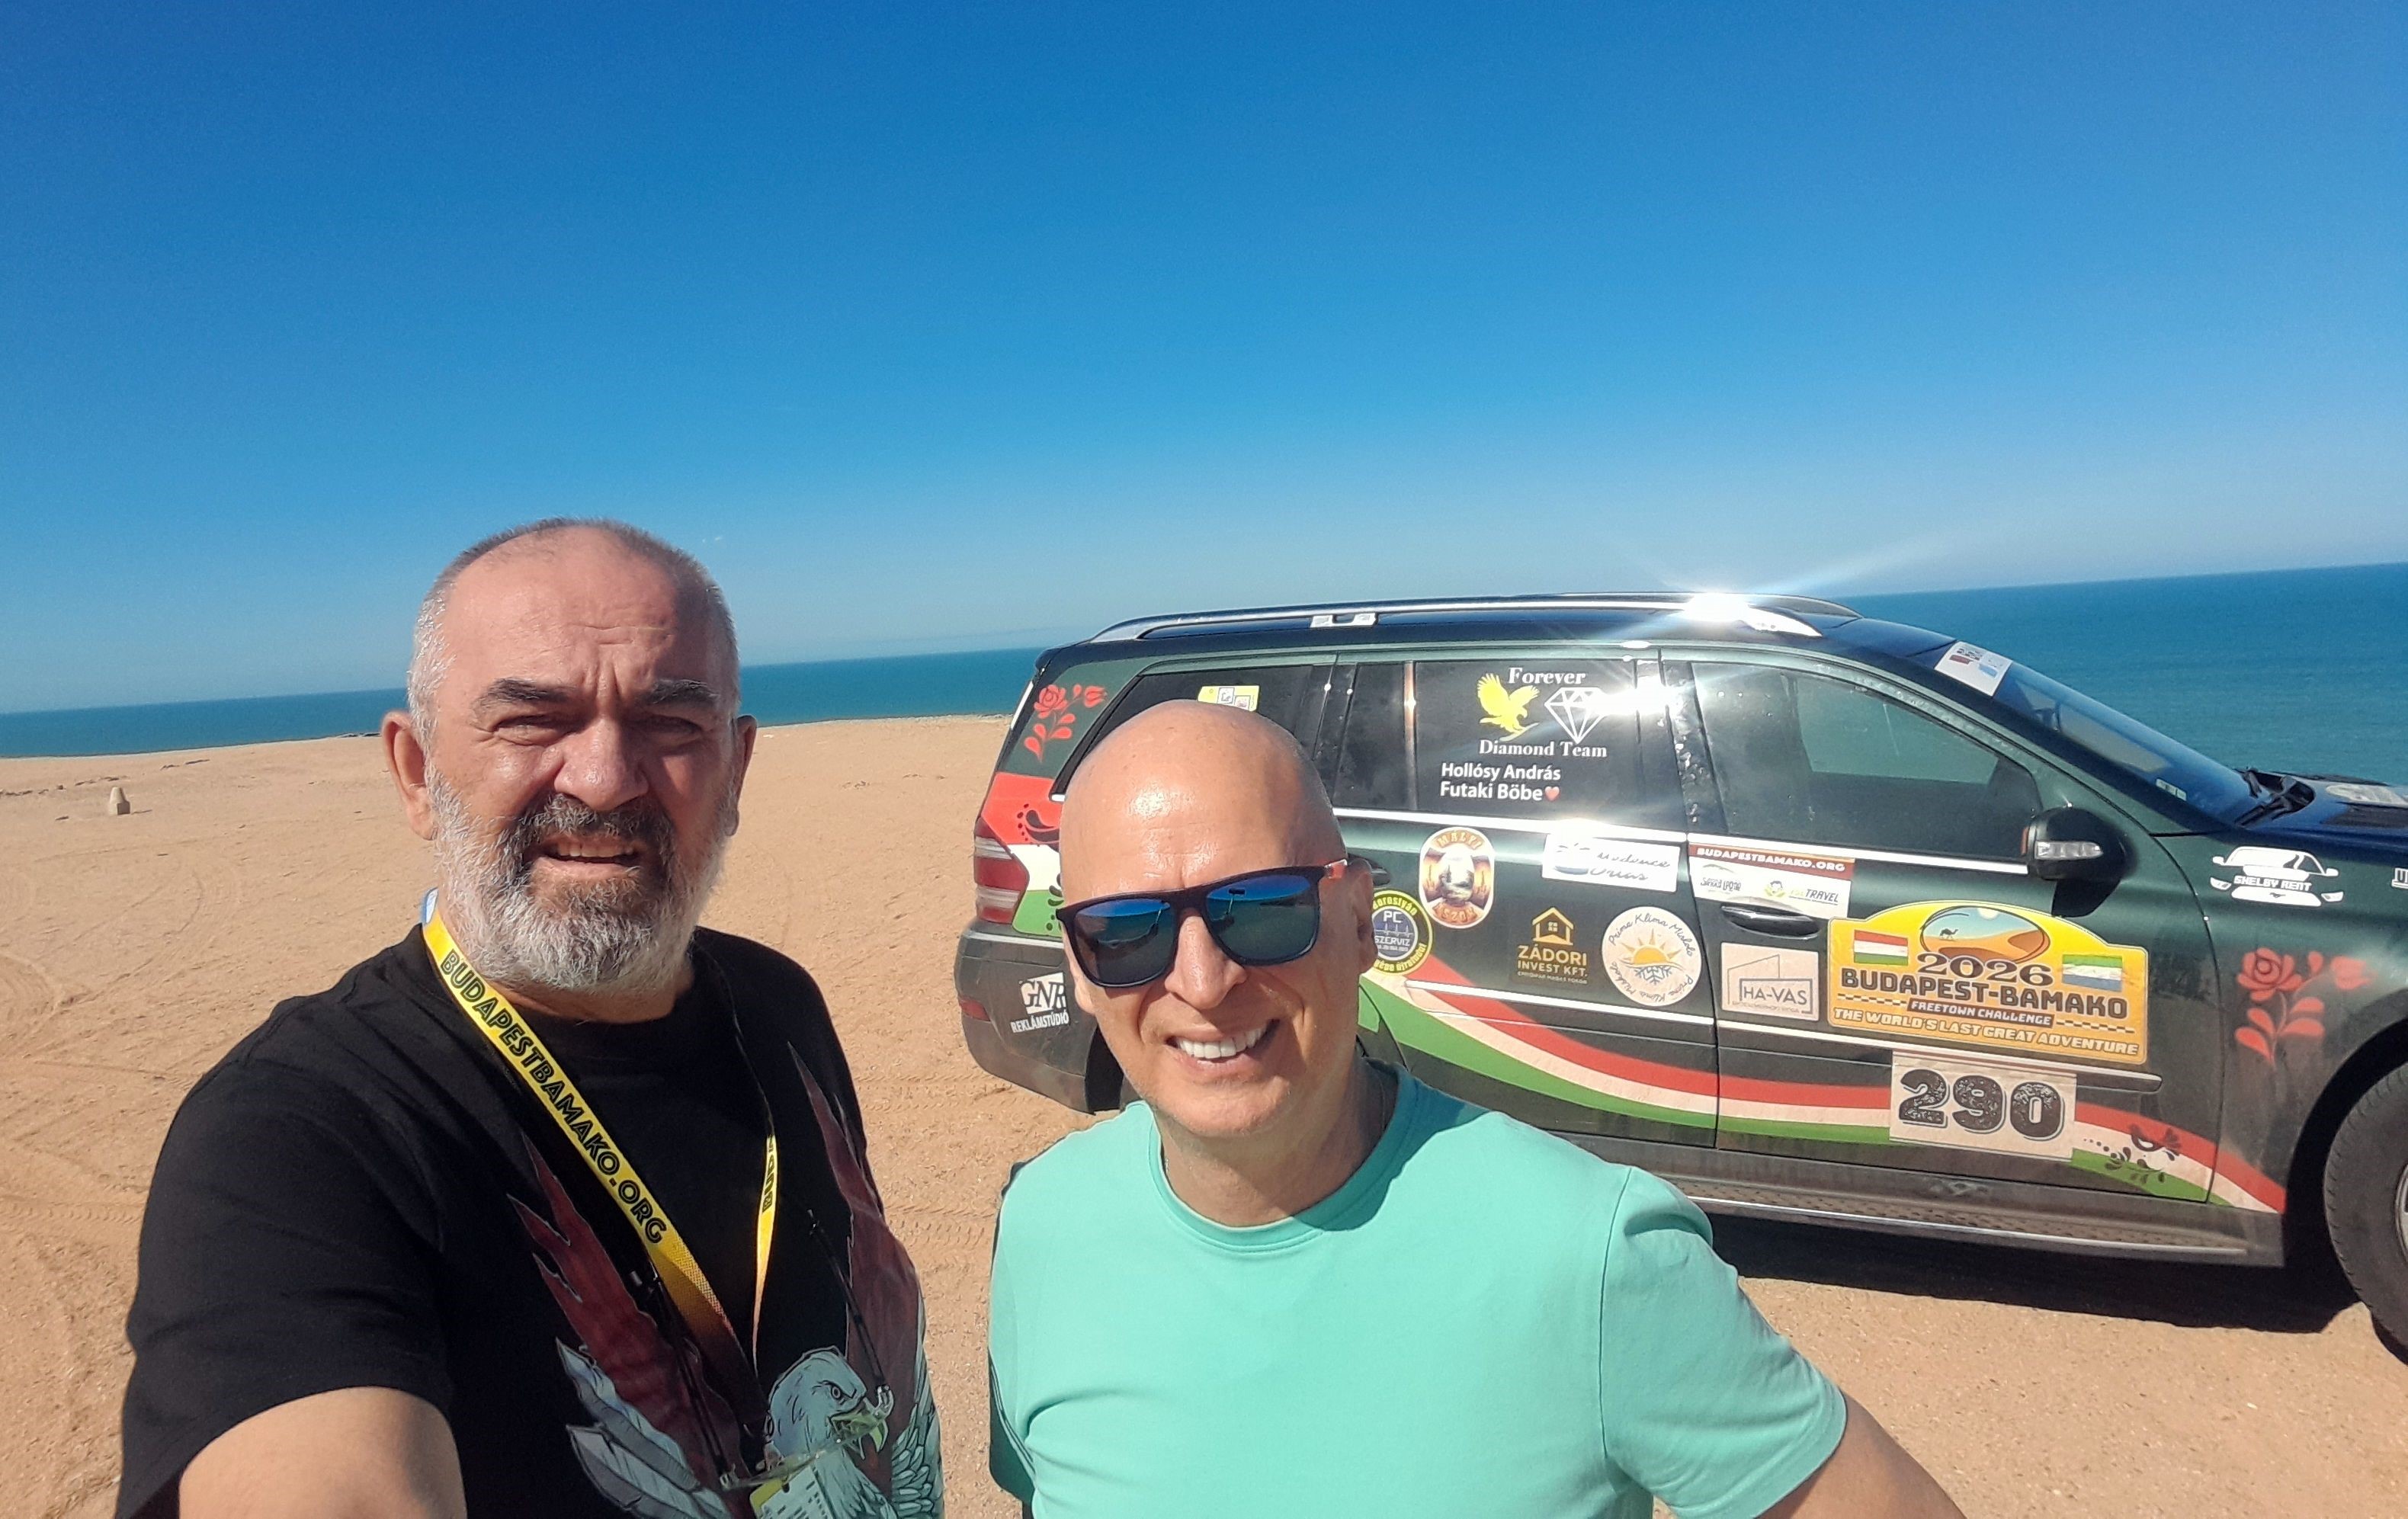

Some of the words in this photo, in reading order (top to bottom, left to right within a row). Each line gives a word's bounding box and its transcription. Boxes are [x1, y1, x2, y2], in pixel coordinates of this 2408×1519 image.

[1508, 667, 1586, 684] Forever
[1479, 739, 1555, 756] Diamond
[1560, 742, 1608, 758] Team
[1441, 762, 1500, 781] Hollósy
[1503, 764, 1561, 780] András
[1440, 781, 1493, 799] Futaki
[1497, 784, 1543, 801] Böbe
[1697, 848, 1845, 872] BUDAPESTBAMAKO.ORG
[2233, 875, 2279, 887] SHELBY
[2281, 880, 2312, 891] RENT
[1805, 889, 1839, 902] TRAVEL
[1383, 910, 1404, 923] PC
[1374, 935, 1411, 947] SZERVIZ
[1518, 944, 1587, 966] ZÁDORI
[1518, 960, 1560, 973] INVEST
[1563, 966, 1588, 977] KFT.
[1917, 953, 2054, 986] 2026
[1743, 986, 1807, 1005] HA-VAS
[1841, 968, 2127, 1019] BUDAPEST-BAMAKO
[1010, 1011, 1069, 1033] REKLÁMSTÚDIÓ
[1911, 1001, 1976, 1016] FREETOWN
[1977, 1008, 2052, 1026] CHALLENGE
[1834, 1008, 1863, 1021] THE
[1866, 1011, 1938, 1030] WORLD'S
[1938, 1023, 1983, 1037] LAST
[1983, 1026, 2036, 1043] GREAT
[2038, 1032, 2139, 1055] ADVENTURE
[440, 949, 666, 1244] BUDAPESTBAMAKO.ORG
[1899, 1069, 2065, 1141] 290
